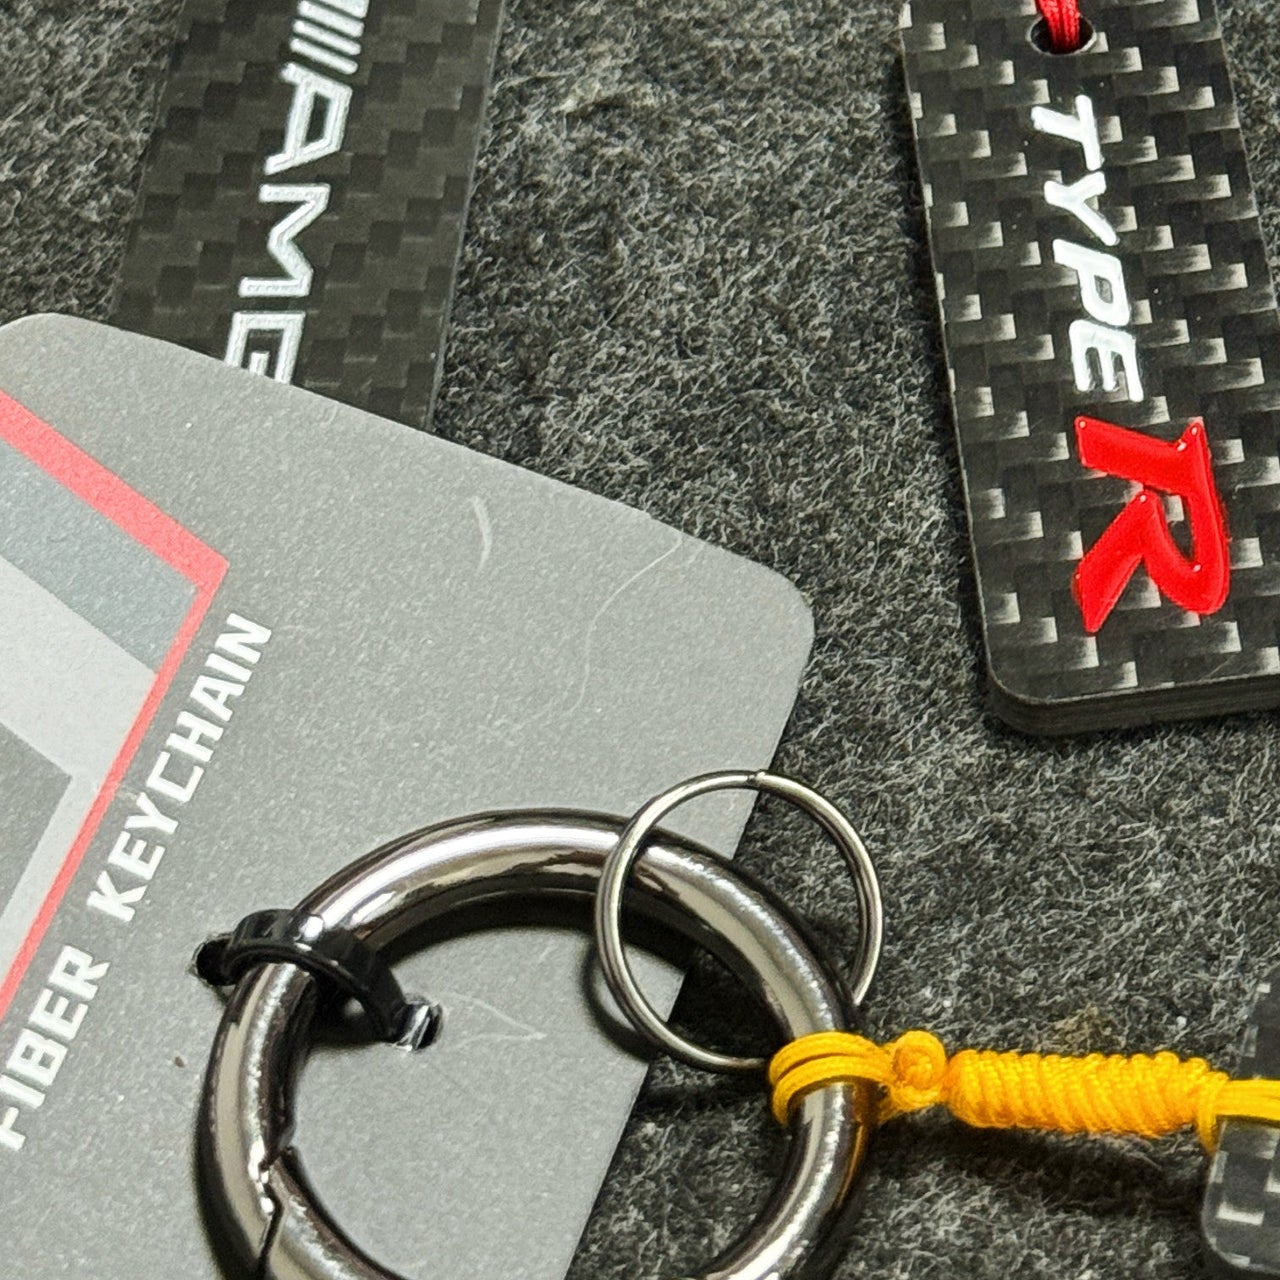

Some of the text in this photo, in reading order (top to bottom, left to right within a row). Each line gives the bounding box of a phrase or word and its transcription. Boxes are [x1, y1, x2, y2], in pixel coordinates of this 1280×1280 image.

[1032, 94, 1230, 634] TYPE R
[87, 613, 272, 922] KEYCHAIN
